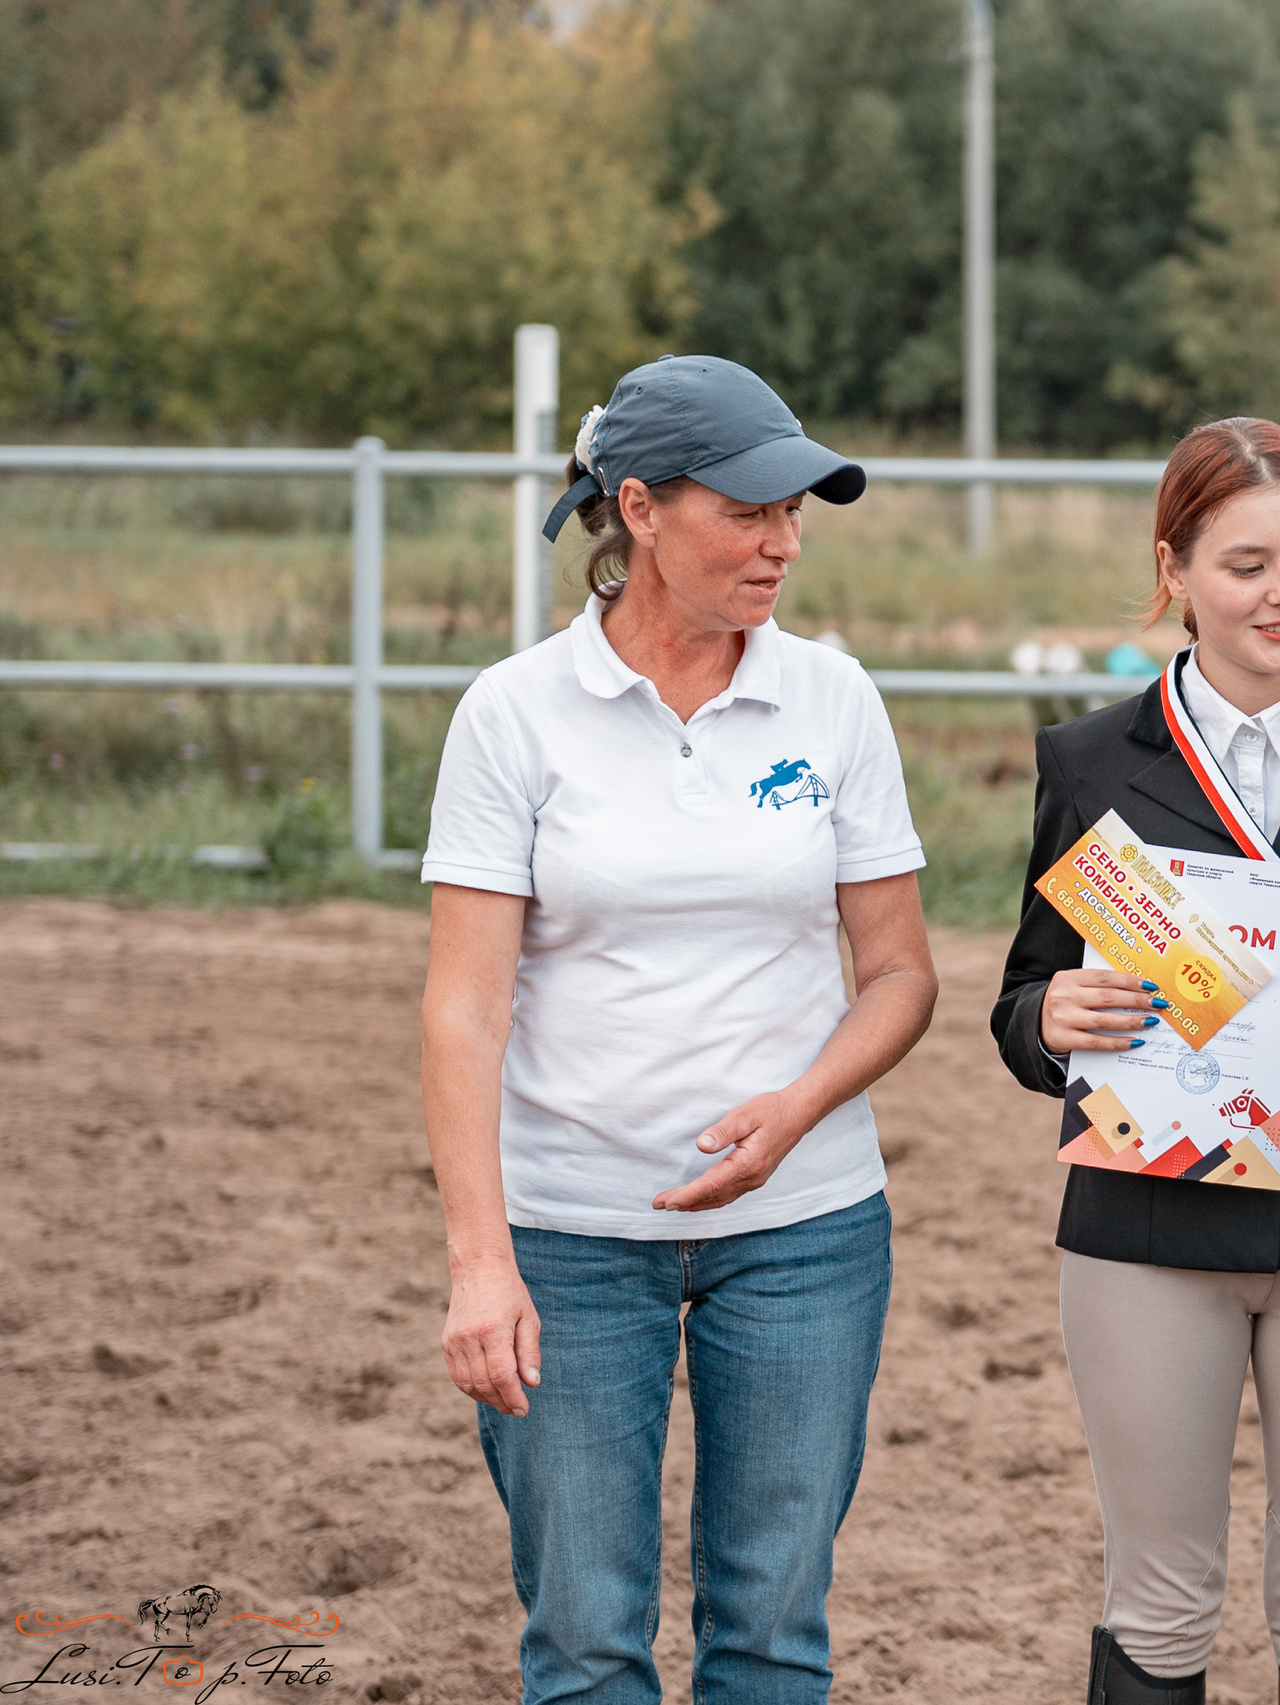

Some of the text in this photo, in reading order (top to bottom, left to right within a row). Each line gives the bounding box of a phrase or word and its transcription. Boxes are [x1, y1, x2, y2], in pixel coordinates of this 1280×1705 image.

[1056, 890, 1106, 947] 68-00-08,
[1074, 855, 1168, 955] КОМБИКОРМА
[1078, 886, 1137, 949] ДОСТАВКА
[1088, 843, 1181, 941] СЕНО ЗЕРНО
[1181, 963, 1215, 999] 10%
[1195, 960, 1217, 982] СКИДКА
